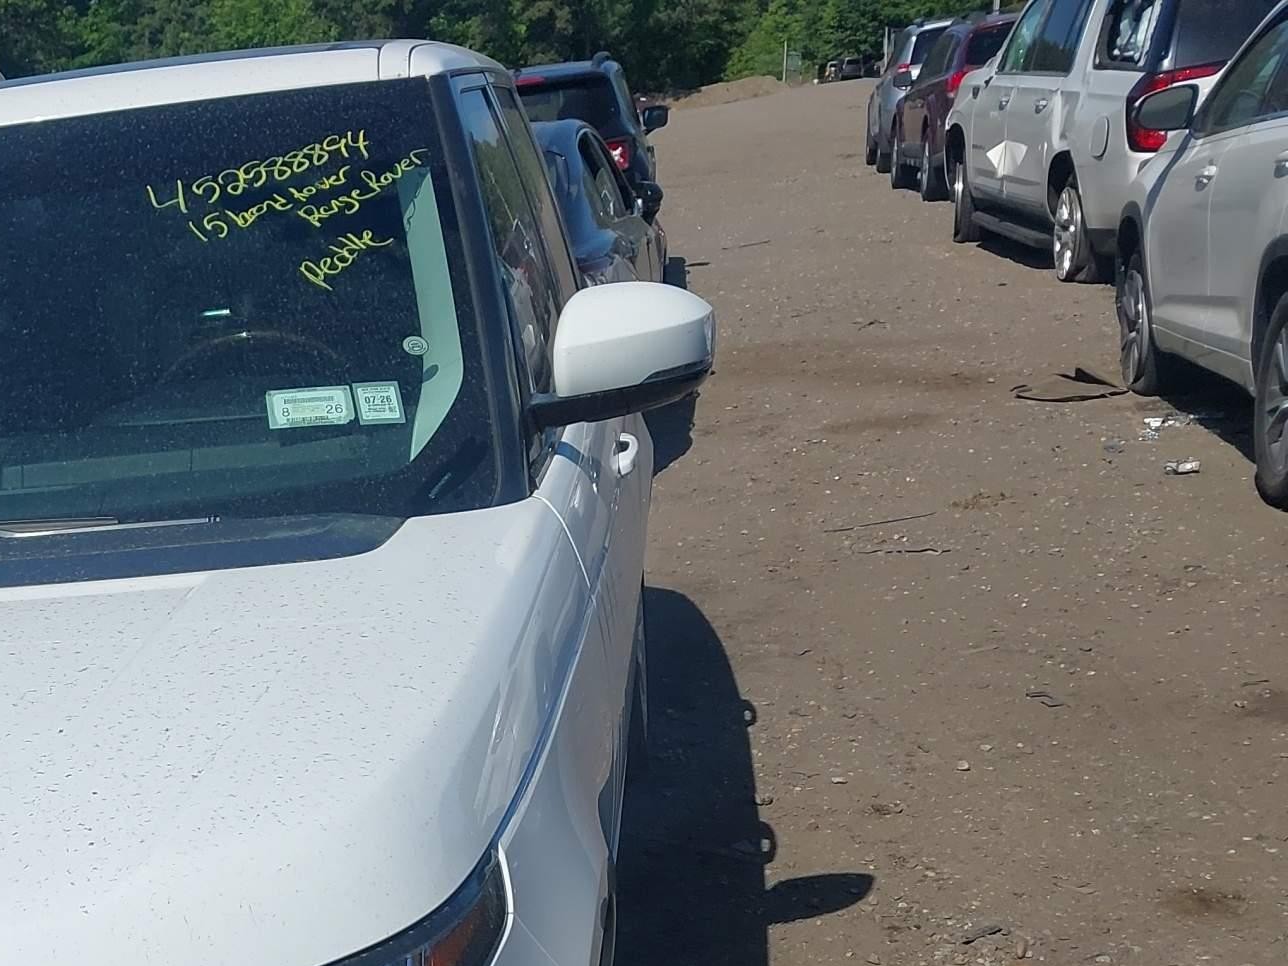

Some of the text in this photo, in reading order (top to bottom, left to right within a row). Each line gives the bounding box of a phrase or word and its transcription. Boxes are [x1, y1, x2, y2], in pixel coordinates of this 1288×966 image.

[146, 128, 370, 213] 45258894
[189, 212, 228, 242] 15
[281, 403, 344, 417] 8 26
